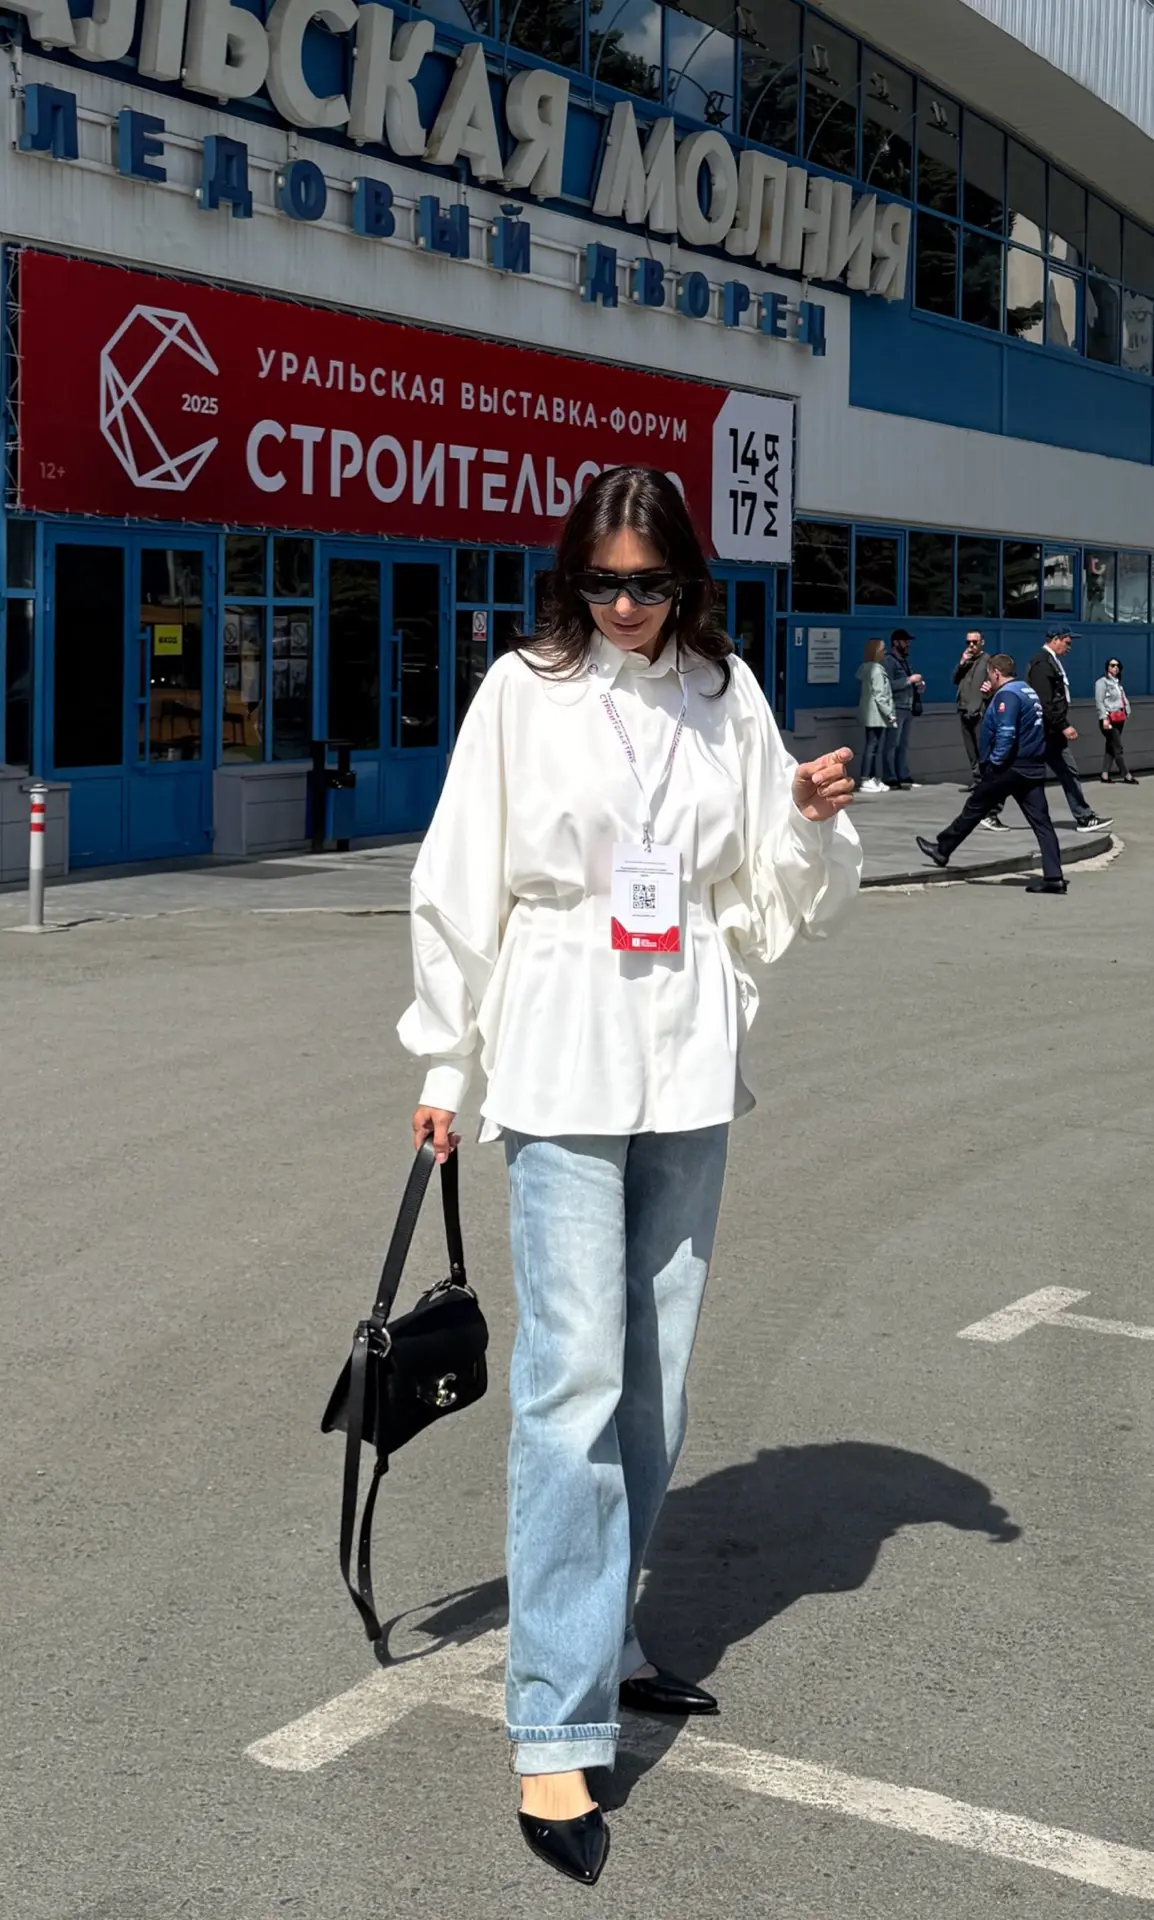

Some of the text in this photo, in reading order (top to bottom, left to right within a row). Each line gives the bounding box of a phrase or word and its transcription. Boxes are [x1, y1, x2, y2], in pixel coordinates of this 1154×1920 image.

[18, 83, 827, 357] ЛЕДОВЫЙ ДВОРЕЦ
[592, 100, 912, 301] МОЛНИЯ
[181, 393, 219, 415] 2025
[257, 347, 688, 443] УРАЛЬСКАЯ ВЫСТАВКА-ФОРУМ
[40, 462, 66, 479] 12+
[245, 419, 686, 518] СТРОИТЕЛЬС
[729, 428, 760, 476] 14
[763, 433, 780, 538] МАЯ
[729, 489, 758, 536] 17
